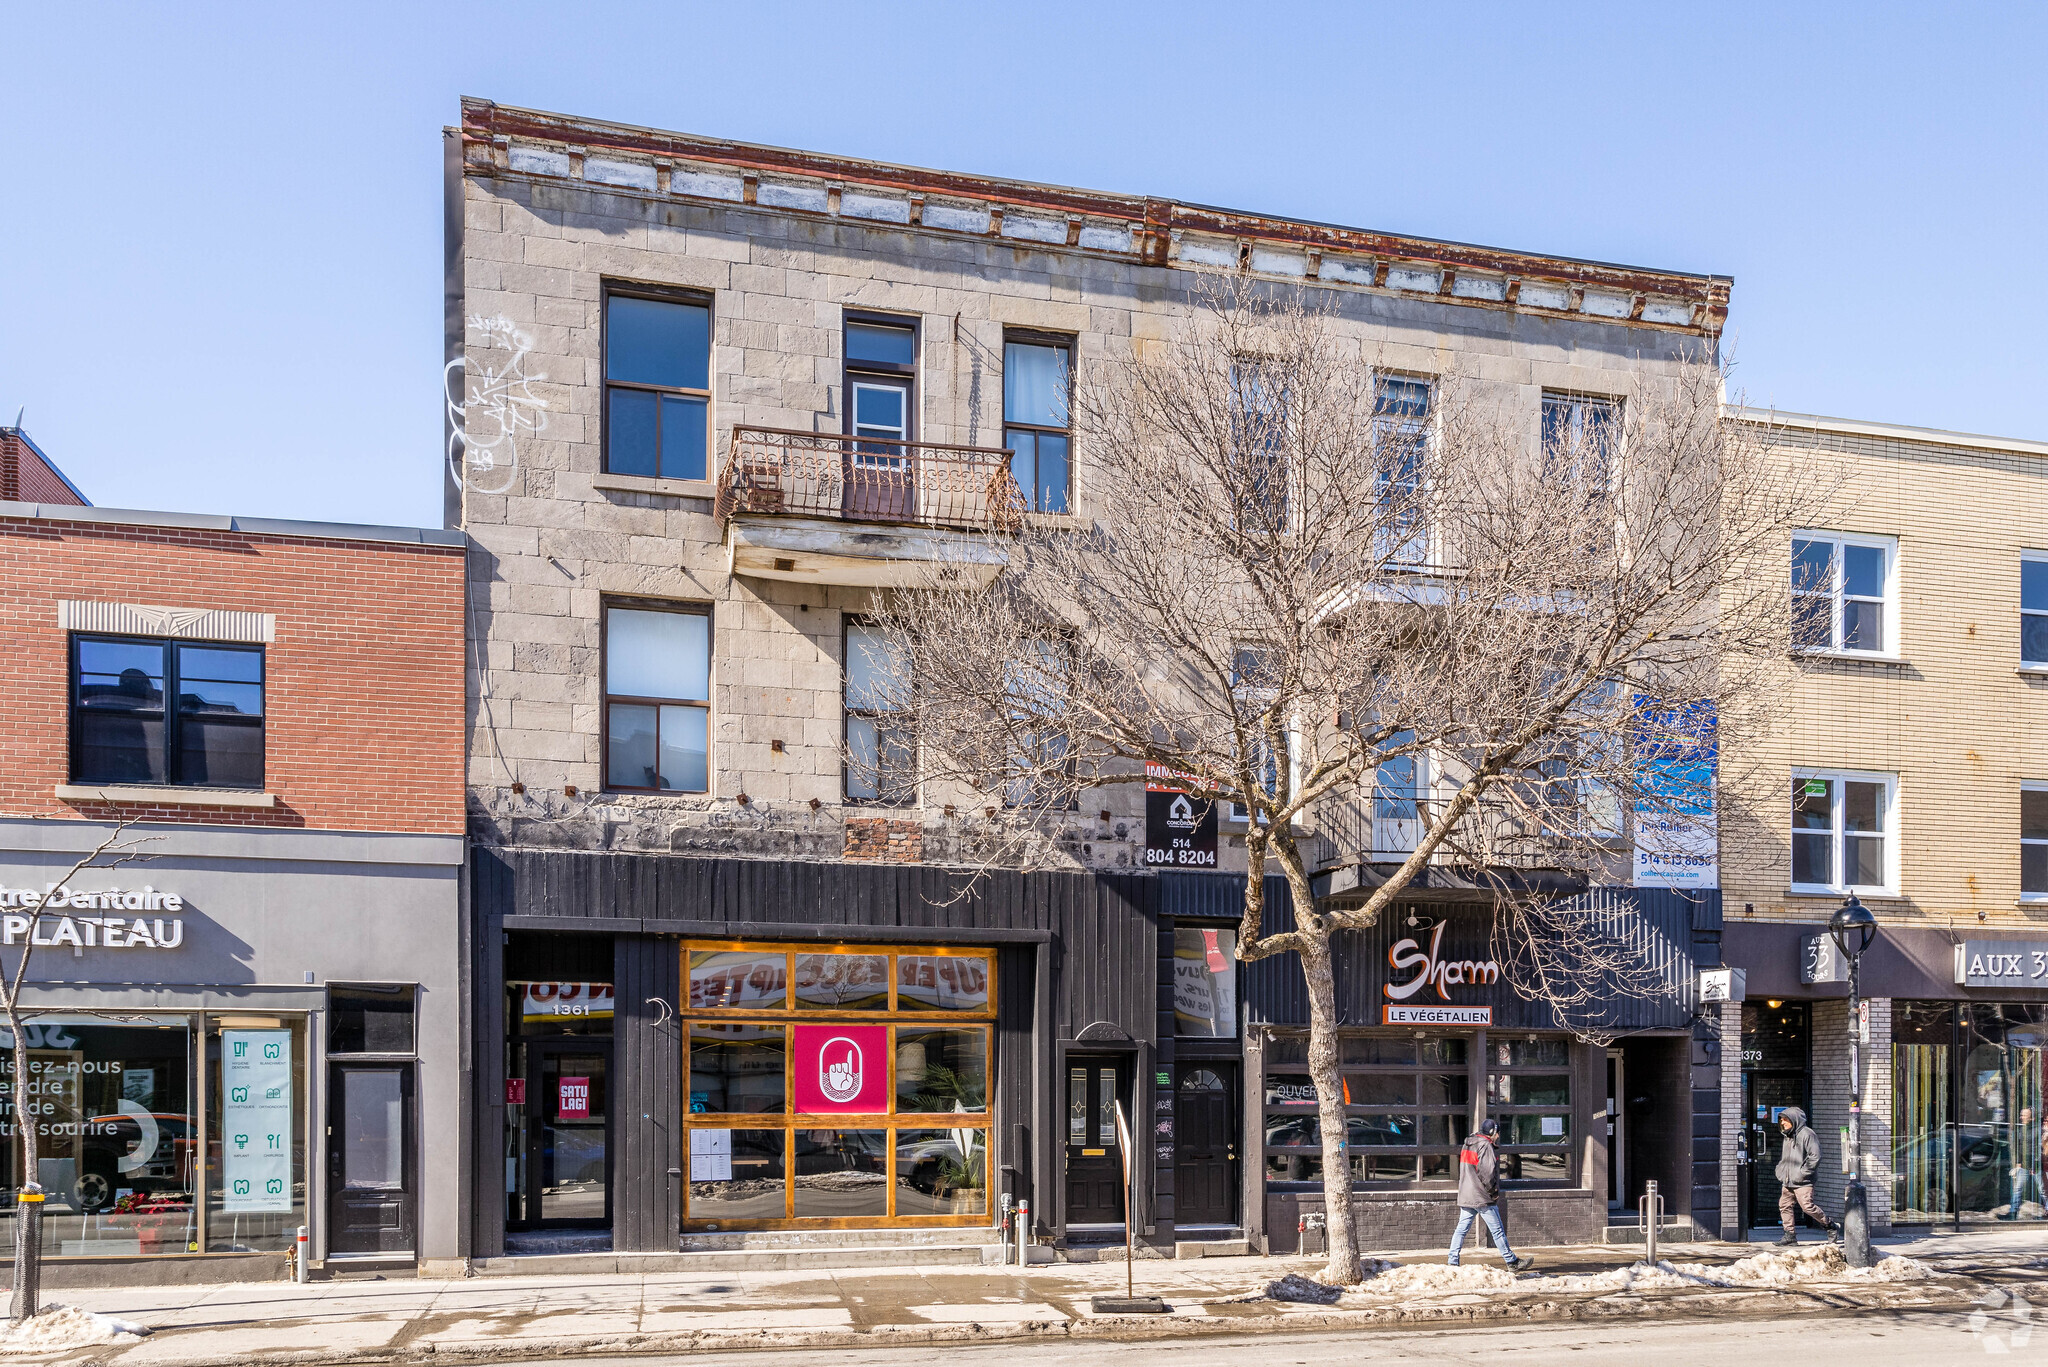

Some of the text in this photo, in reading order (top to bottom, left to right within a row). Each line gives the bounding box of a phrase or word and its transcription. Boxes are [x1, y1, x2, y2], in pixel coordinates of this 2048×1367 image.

[1172, 838, 1191, 849] 514
[1146, 848, 1216, 865] 804 8204
[1640, 853, 1660, 865] 514
[46, 882, 184, 912] Dentaire
[3, 915, 184, 949] PLATEAU
[1810, 936, 1826, 945] AUX
[1383, 918, 1499, 1000] Sham
[1806, 945, 1830, 970] 33
[1967, 950, 2048, 979] AUX 3
[1806, 969, 1829, 981] TOURS
[552, 1004, 590, 1016] 1361
[1391, 1009, 1489, 1023] LE VÉGÉTALIEN
[1740, 1050, 1763, 1061] 1373
[0, 1057, 122, 1074] isez-nous
[560, 1085, 588, 1098] SATU
[1276, 1085, 1318, 1097] OUVER
[27, 1097, 55, 1115] de
[561, 1098, 586, 1111] LAGI
[39, 1120, 118, 1136] sourire
